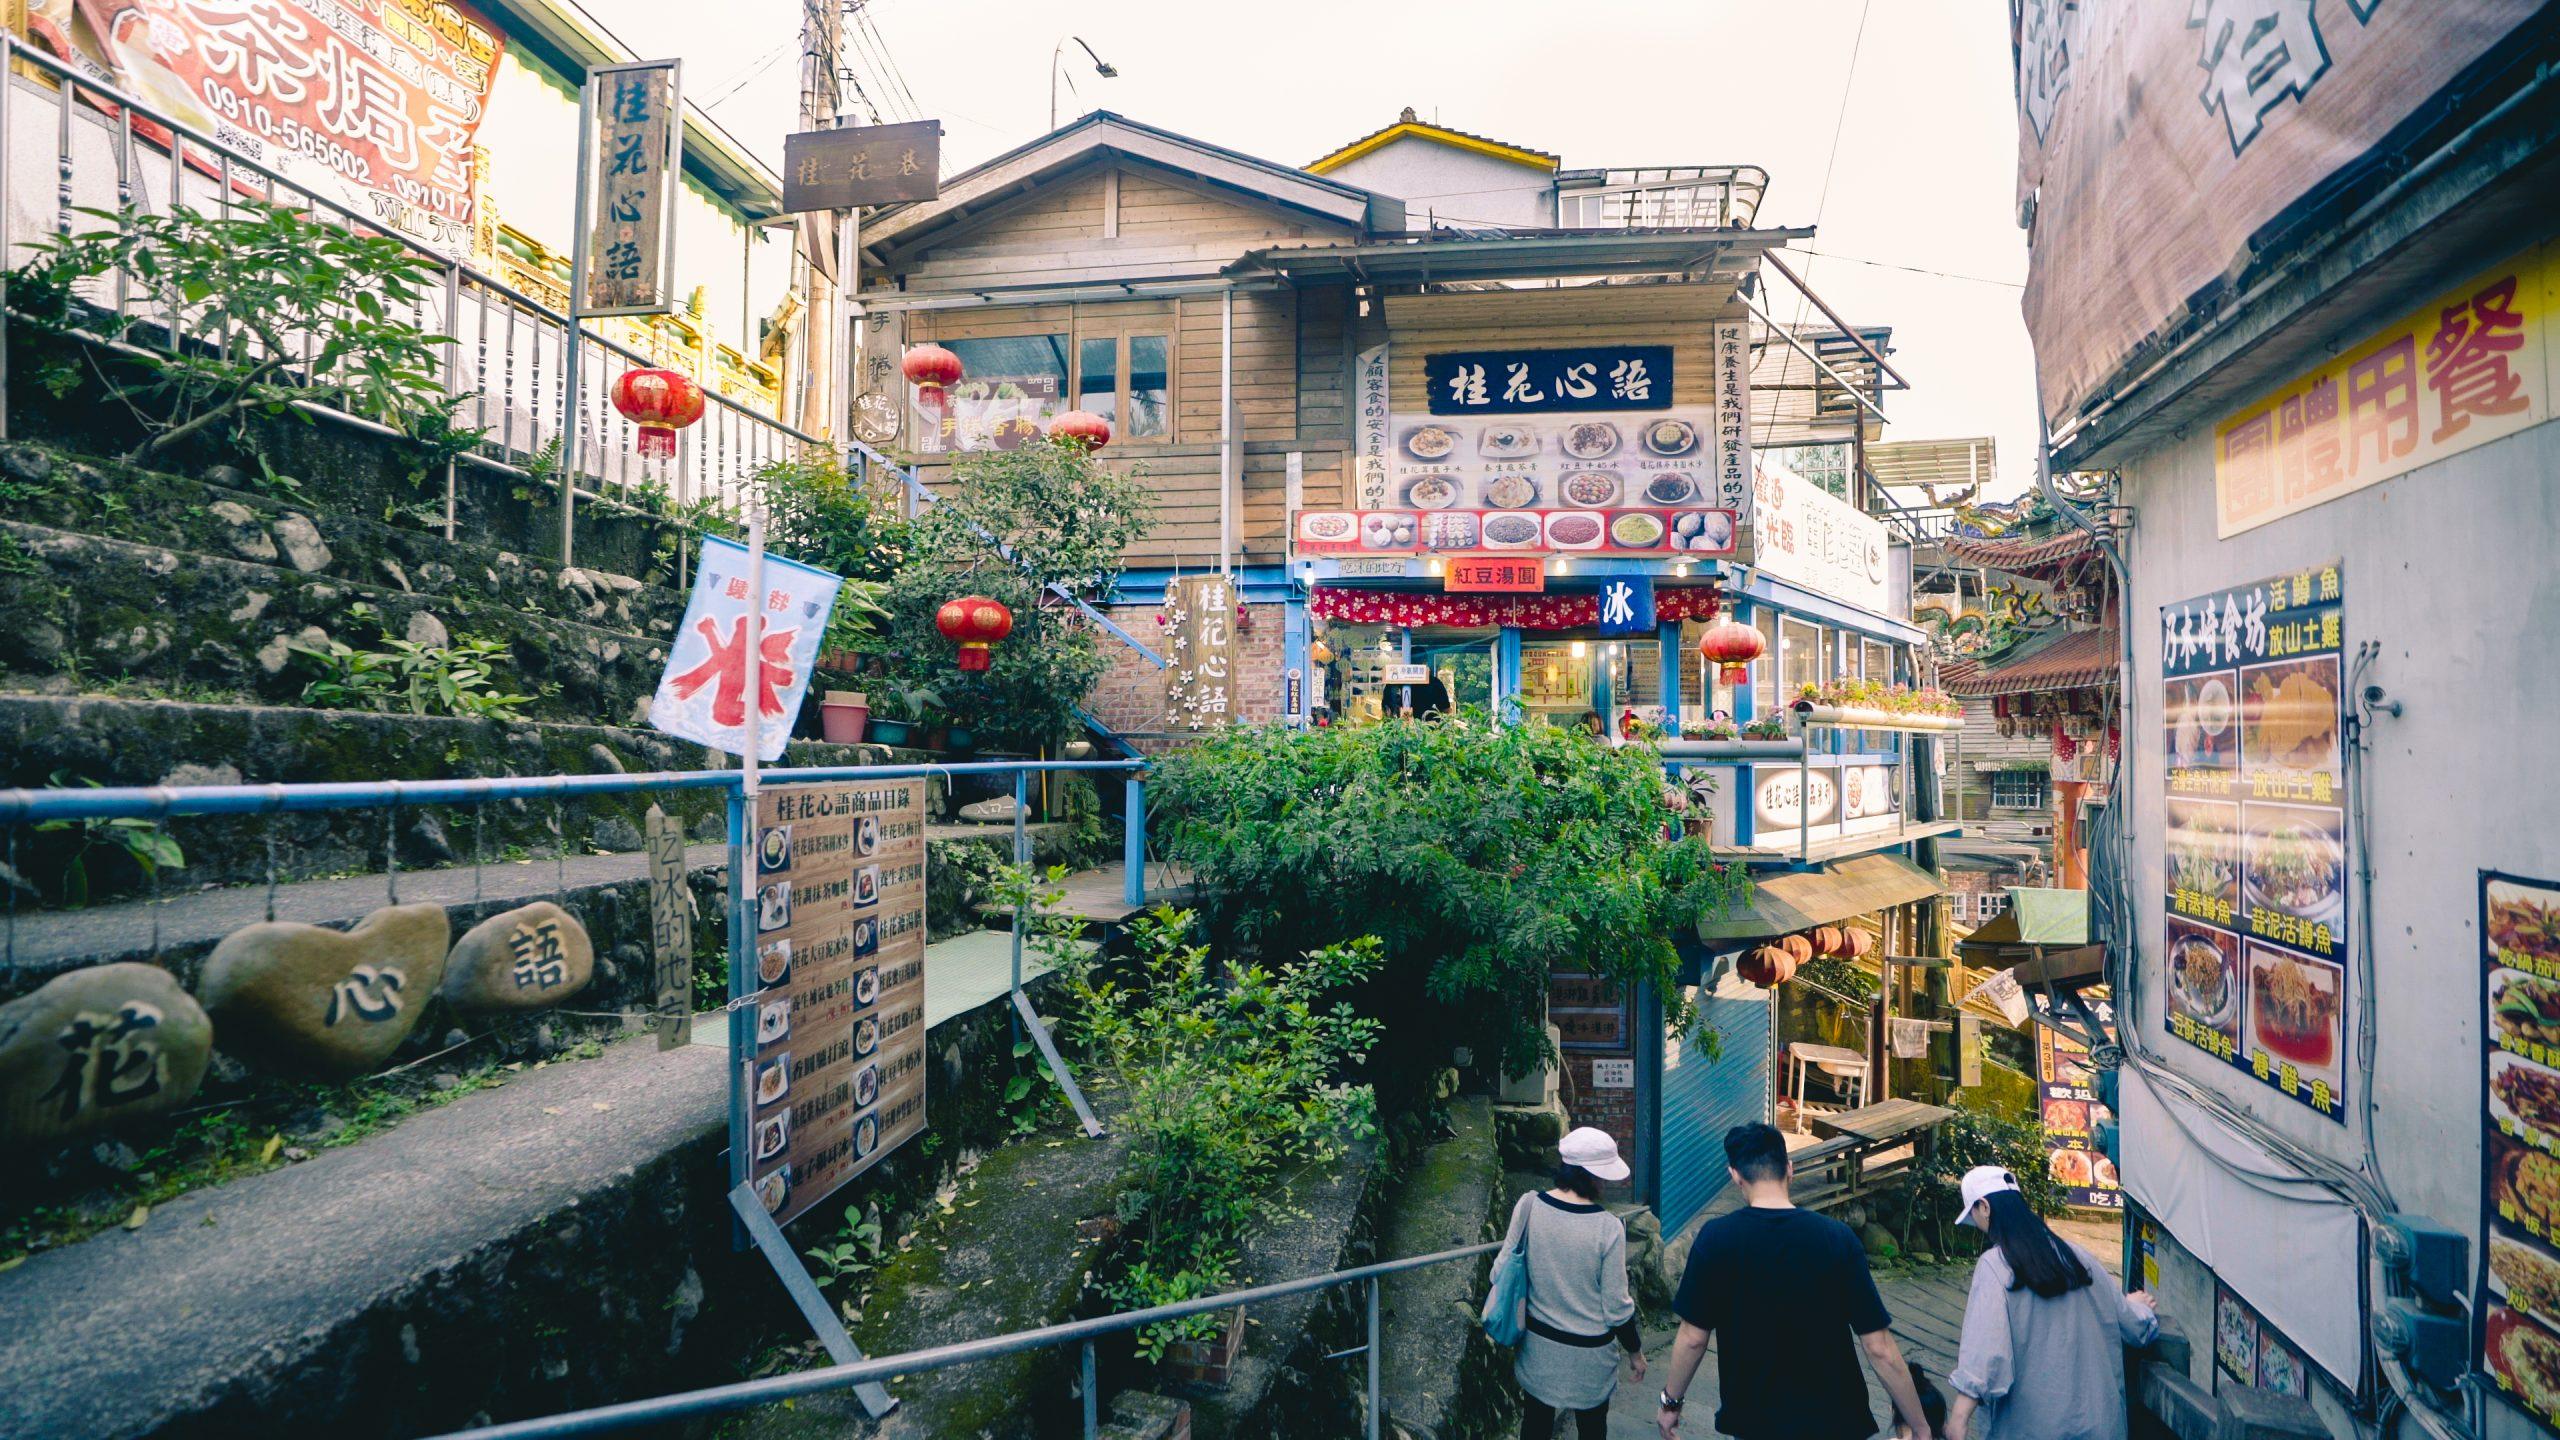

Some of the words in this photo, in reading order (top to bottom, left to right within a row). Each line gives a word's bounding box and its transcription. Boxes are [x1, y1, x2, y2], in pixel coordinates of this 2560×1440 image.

[203, 78, 373, 185] 0910-565602
[607, 81, 648, 281] 桂花心語
[1448, 358, 1653, 406] 桂花心語
[2224, 275, 2530, 524] 團體用餐
[1453, 566, 1537, 585] 紅豆湯圓
[2269, 567, 2340, 612] 活鱒魚
[1602, 581, 1634, 624] 冰
[1199, 582, 1229, 715] 桂花心語
[2269, 612, 2340, 657] 放山土雞
[777, 787, 910, 822] 桂花心語商品目錄
[1766, 783, 1831, 809] 桂花心語品系列
[2253, 770, 2332, 802] 放山土雞
[2174, 887, 2231, 926] 清蒸鱒魚
[2252, 906, 2332, 955] 蒜泥活鱒魚
[507, 917, 570, 990] 語
[649, 821, 690, 1043] 吃冰的地方
[324, 963, 407, 1028] 心
[2173, 1010, 2233, 1063] 豆酥活鱒魚
[2252, 1046, 2332, 1113] 糖醋魚
